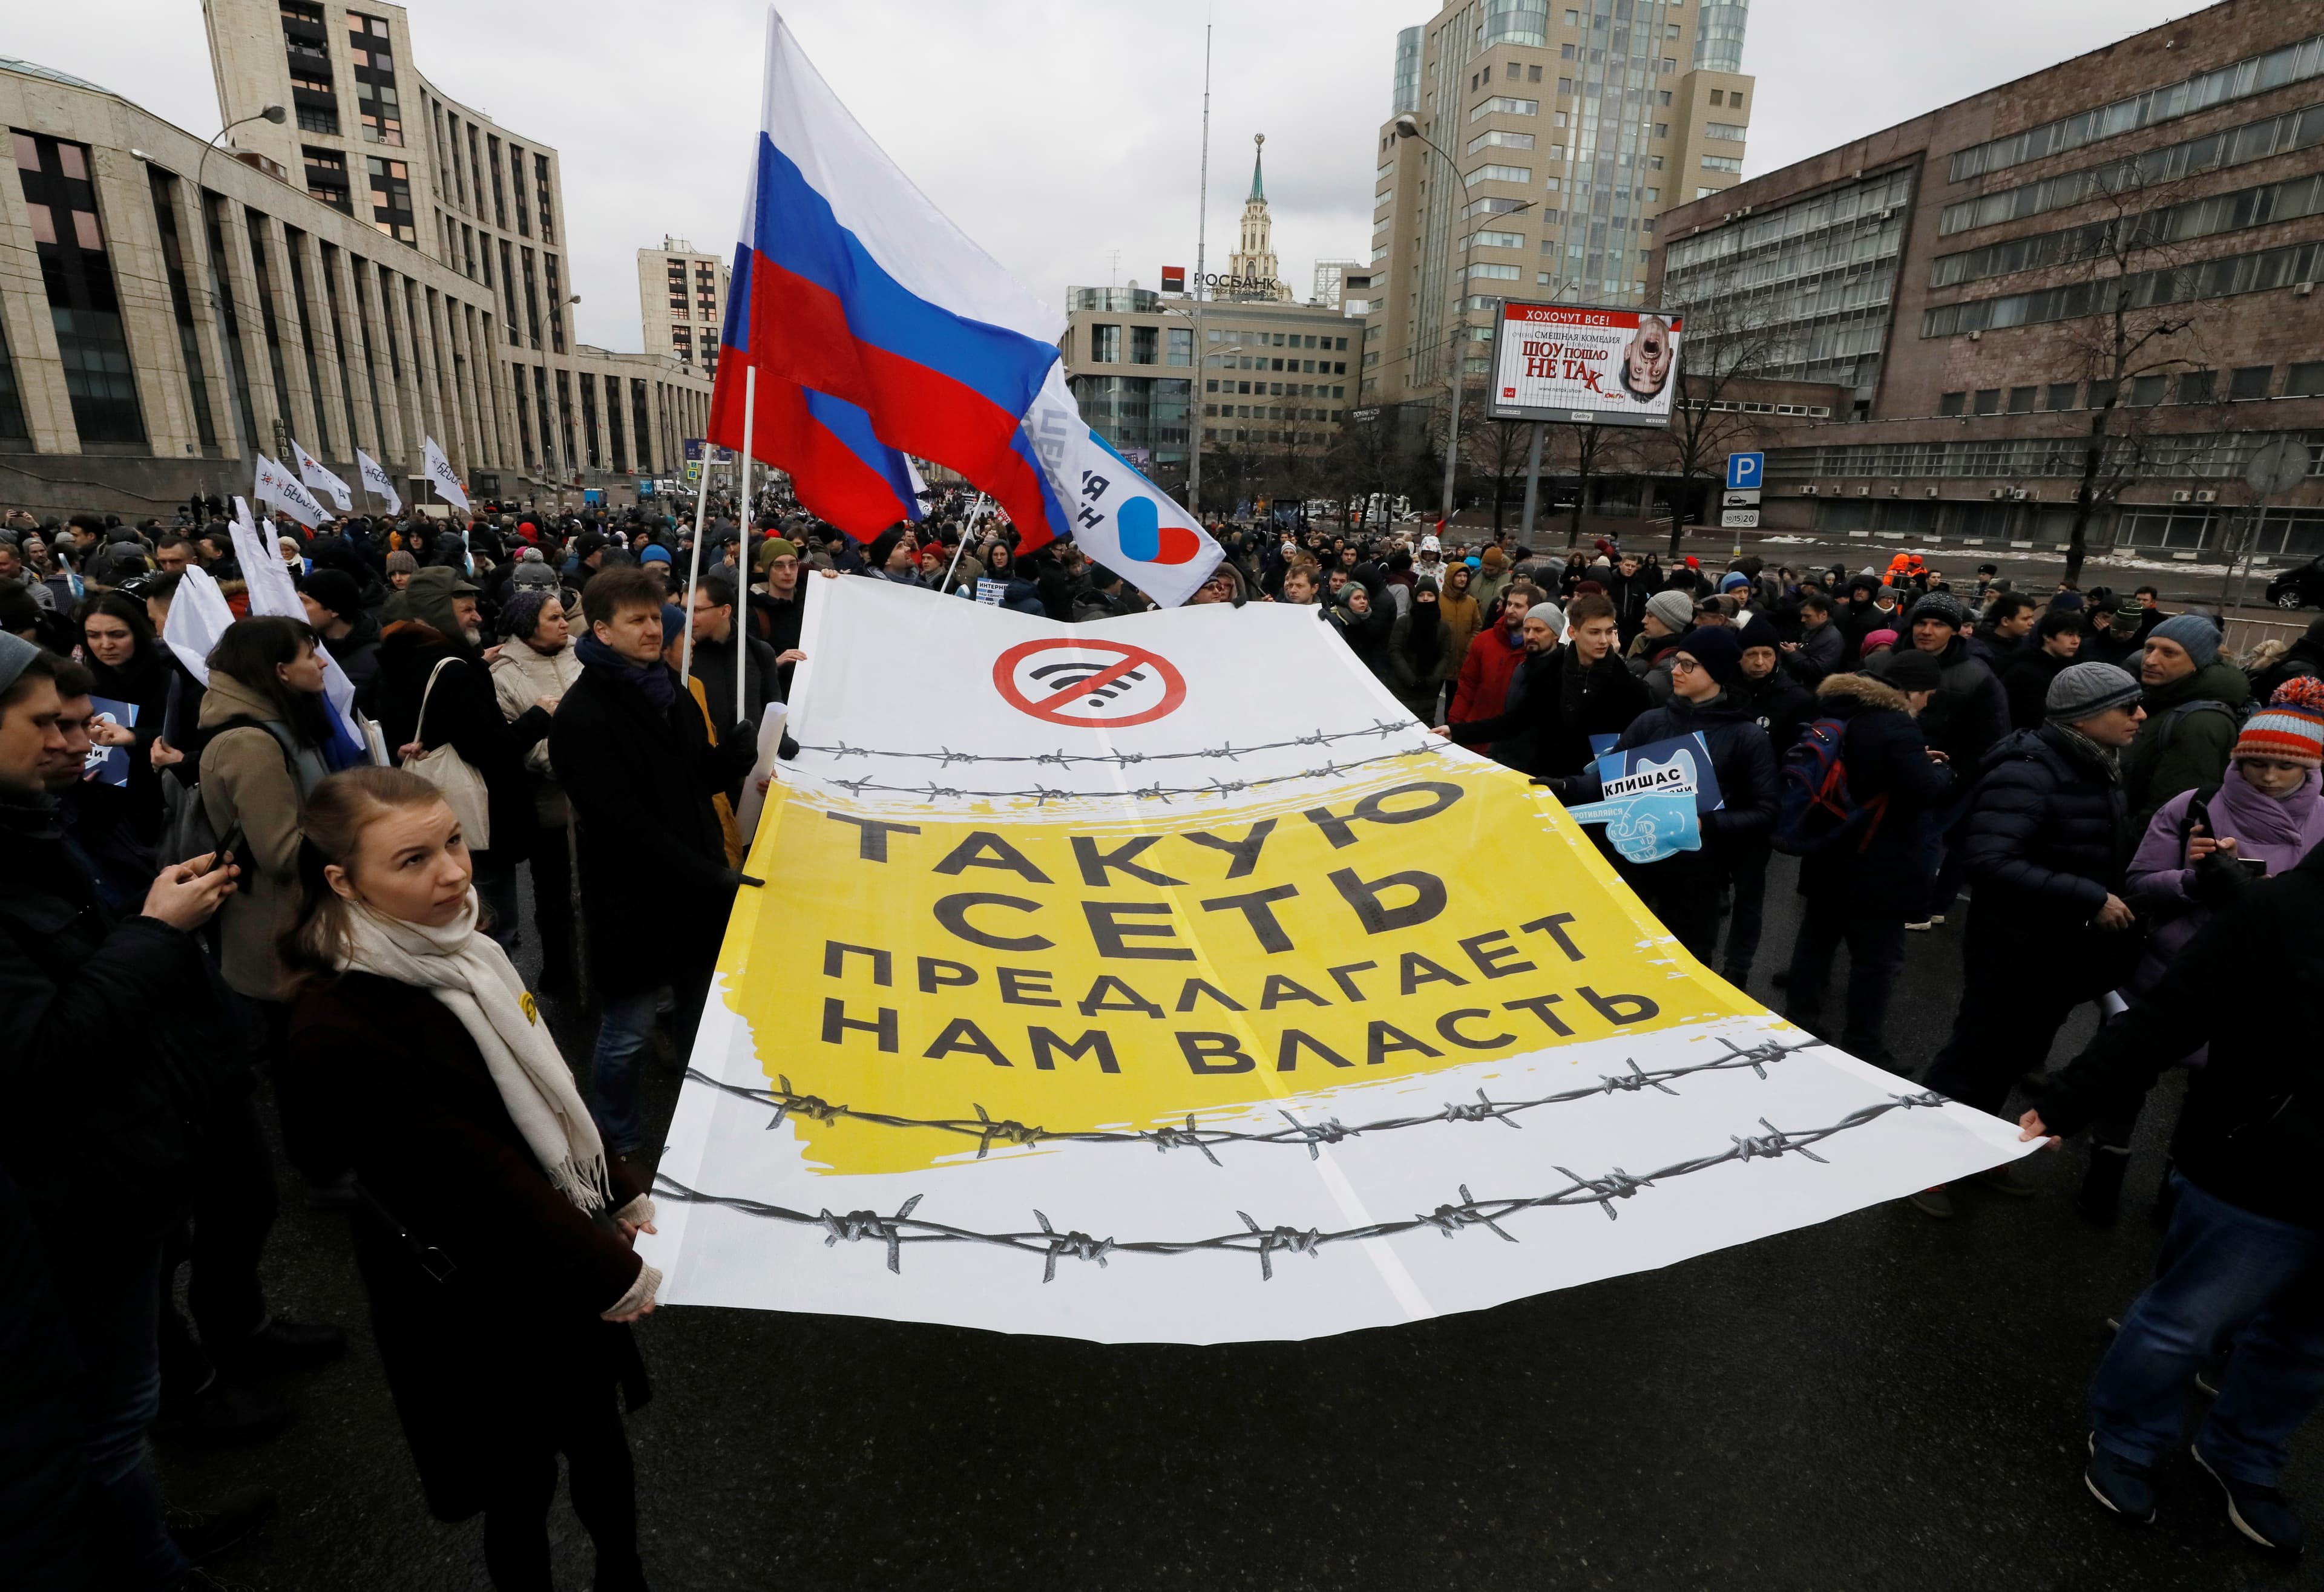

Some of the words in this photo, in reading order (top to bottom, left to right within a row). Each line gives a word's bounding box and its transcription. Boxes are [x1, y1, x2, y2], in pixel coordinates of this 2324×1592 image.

[1194, 272, 1276, 290] РОСБАНК
[1526, 310, 1581, 323] ХОХОЧУТ
[1585, 314, 1610, 326] ВСЕ!
[1522, 341, 1564, 358] ШОУ
[1535, 331, 1578, 341] СМЕШНАЯ
[1581, 335, 1621, 344] КОМЕДИЯ
[1564, 347, 1608, 361] ПОШЛО
[1526, 357, 1557, 379] НЕ
[1562, 359, 1604, 394] ТАК
[1736, 457, 1755, 484] P
[1604, 768, 1681, 797] КЛИШАС
[827, 782, 1463, 886] ТАКУЮ
[933, 868, 1447, 960] СЕТЬ
[824, 912, 1586, 1018] ПРЕДЛАГАЕТ
[822, 997, 1121, 1073] НАМ
[1175, 986, 1659, 1074] ВЛАСТЬ
